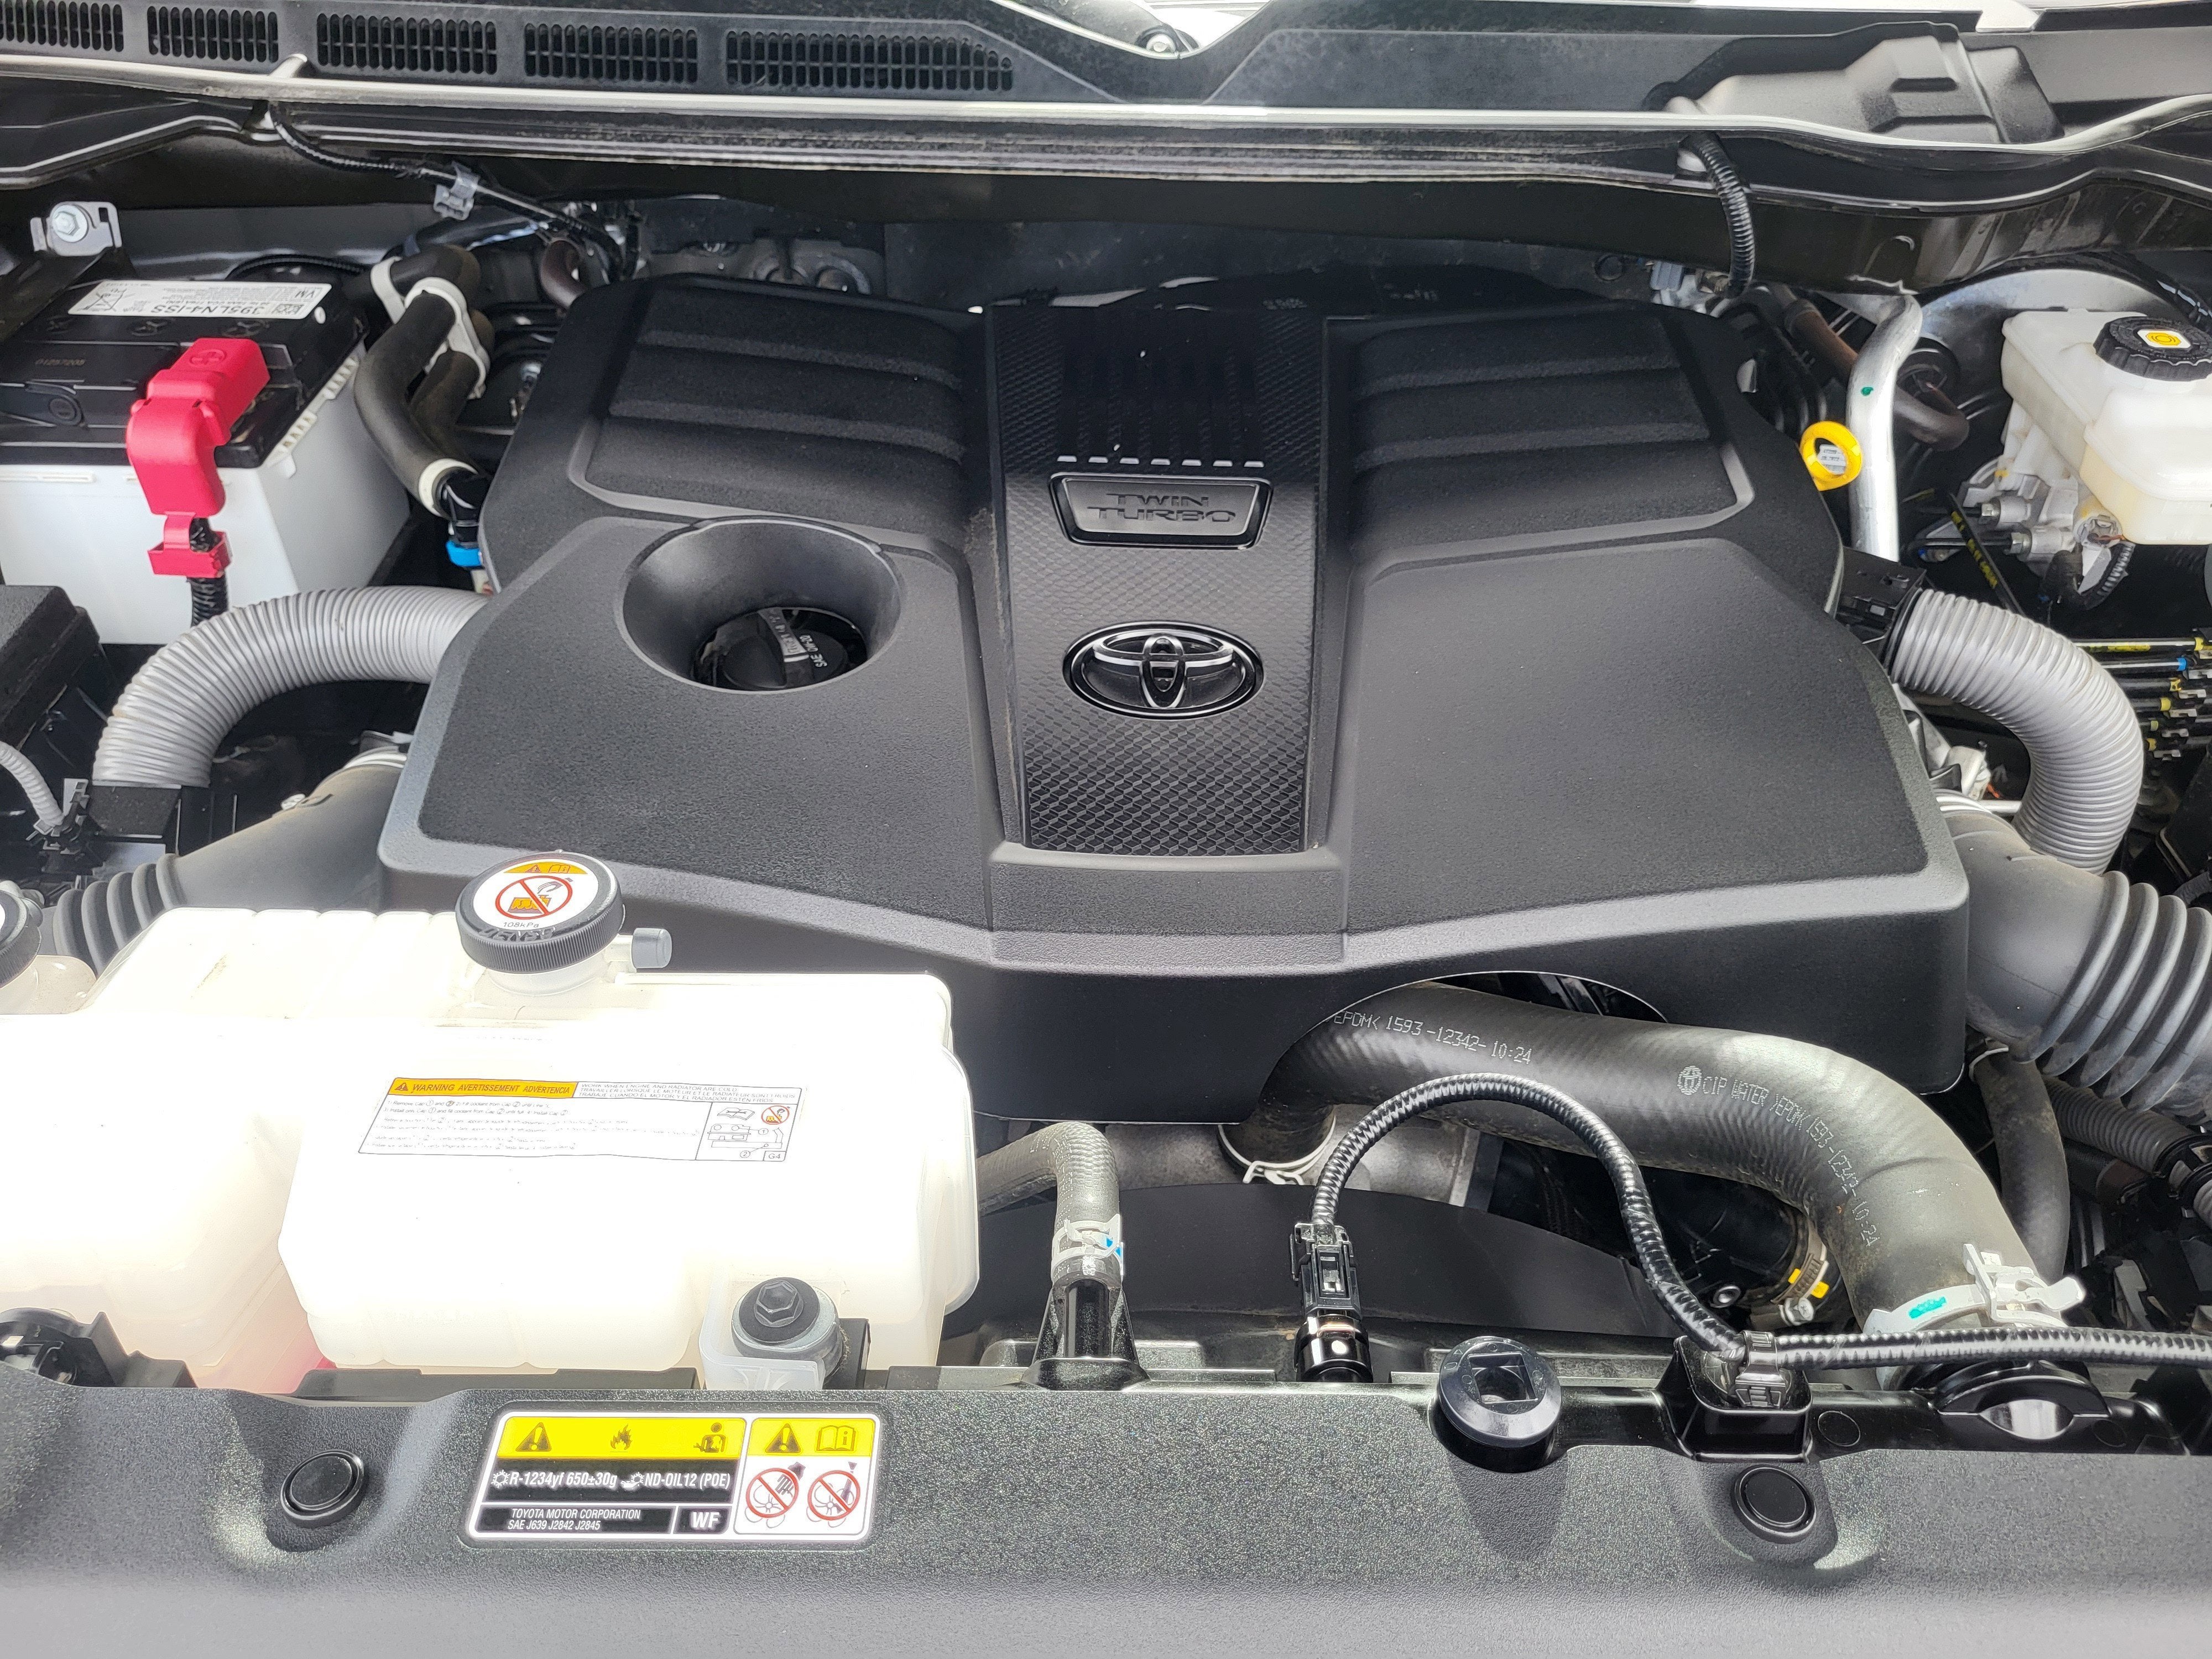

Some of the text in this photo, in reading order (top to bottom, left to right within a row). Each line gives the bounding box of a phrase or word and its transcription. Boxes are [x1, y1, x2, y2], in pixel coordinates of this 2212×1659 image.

[1106, 493, 1209, 507] TWIN
[1087, 506, 1237, 523] TURBO
[810, 653, 828, 667] SAE
[480, 926, 556, 942] DENSO
[1386, 1015, 1424, 1036] 1593
[1491, 1040, 1532, 1065] 10:24
[412, 1083, 570, 1094] WARNING AVERTISSEMENT ADVERTENCIA
[1702, 1076, 1728, 1095] CIP
[1731, 1079, 1770, 1107] WATER
[509, 1471, 618, 1488] R-1234yf 650±30g
[644, 1473, 731, 1490] ND-OIL12 (POE)
[512, 1508, 641, 1520] TOYOTA MOTOR CORPORATION
[691, 1511, 721, 1528] WF
[508, 1520, 601, 1531] SAE J639 J2842 J2845
